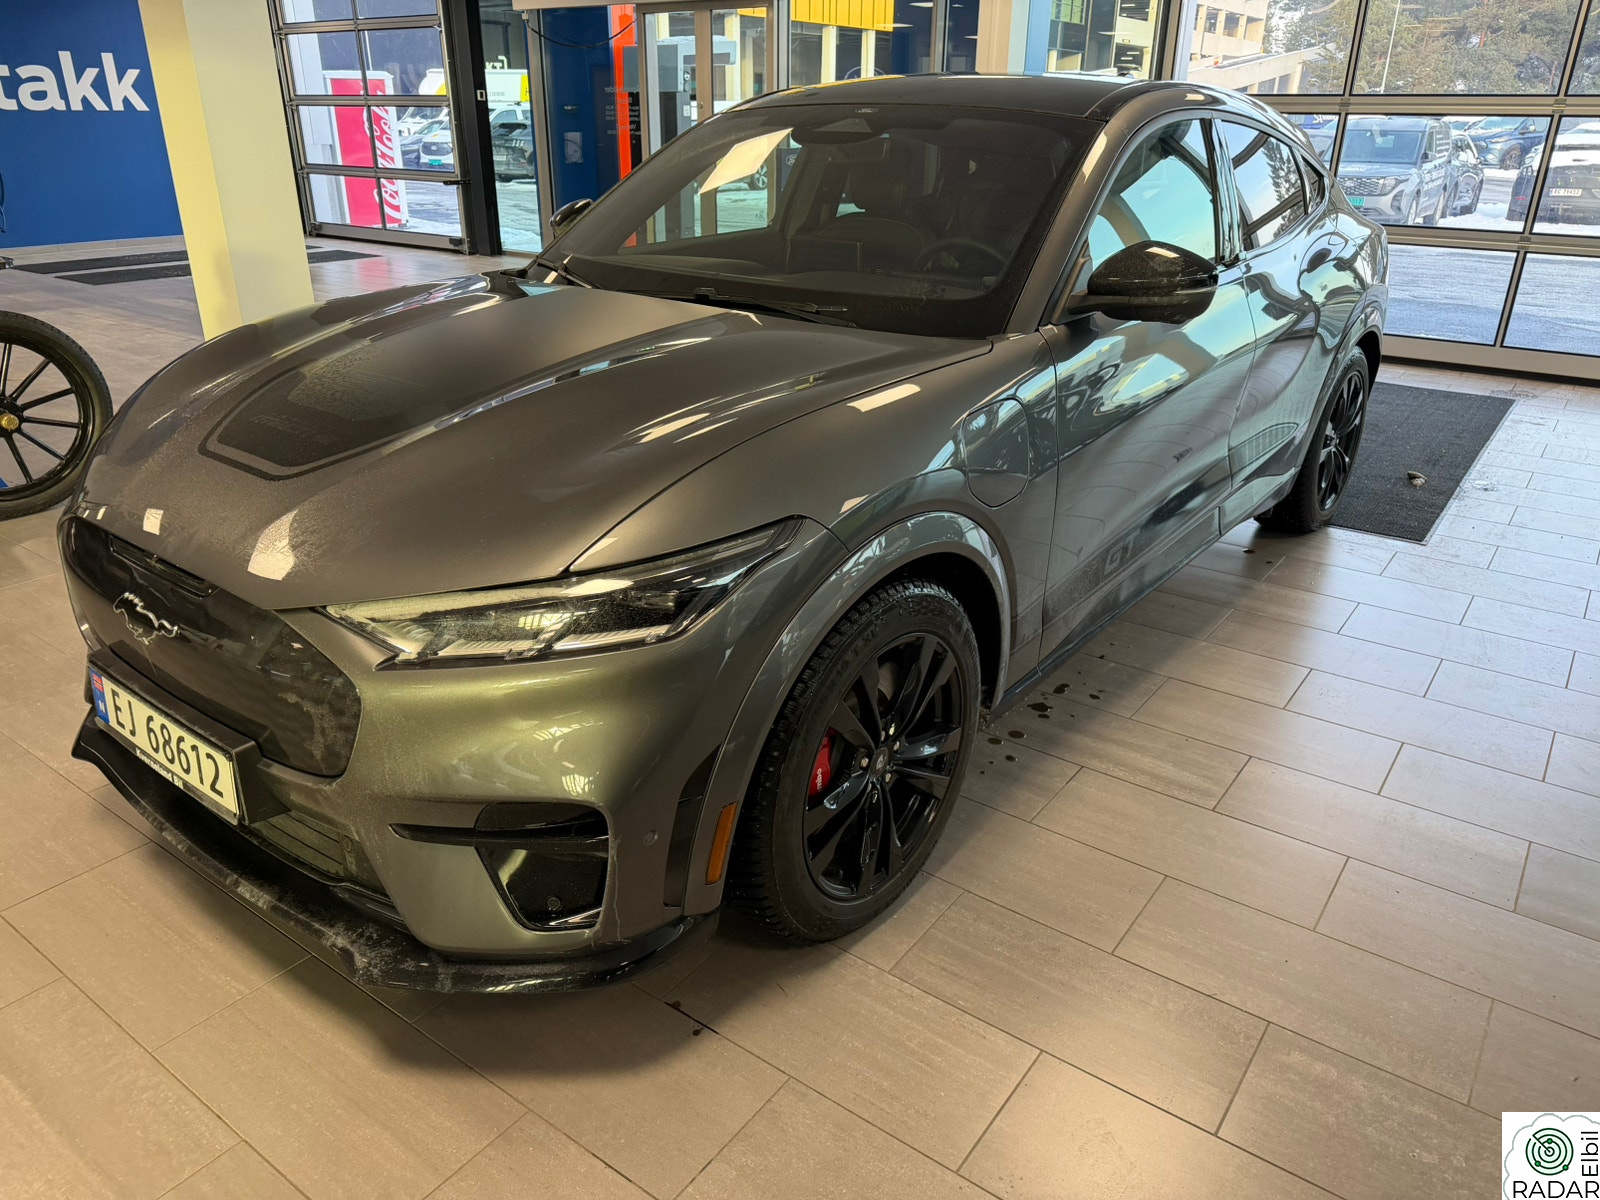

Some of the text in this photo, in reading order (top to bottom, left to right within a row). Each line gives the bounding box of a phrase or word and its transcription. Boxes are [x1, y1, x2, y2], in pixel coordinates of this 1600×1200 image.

[0, 50, 150, 112] takk
[110, 687, 137, 738] EJ
[145, 714, 225, 799] 68612
